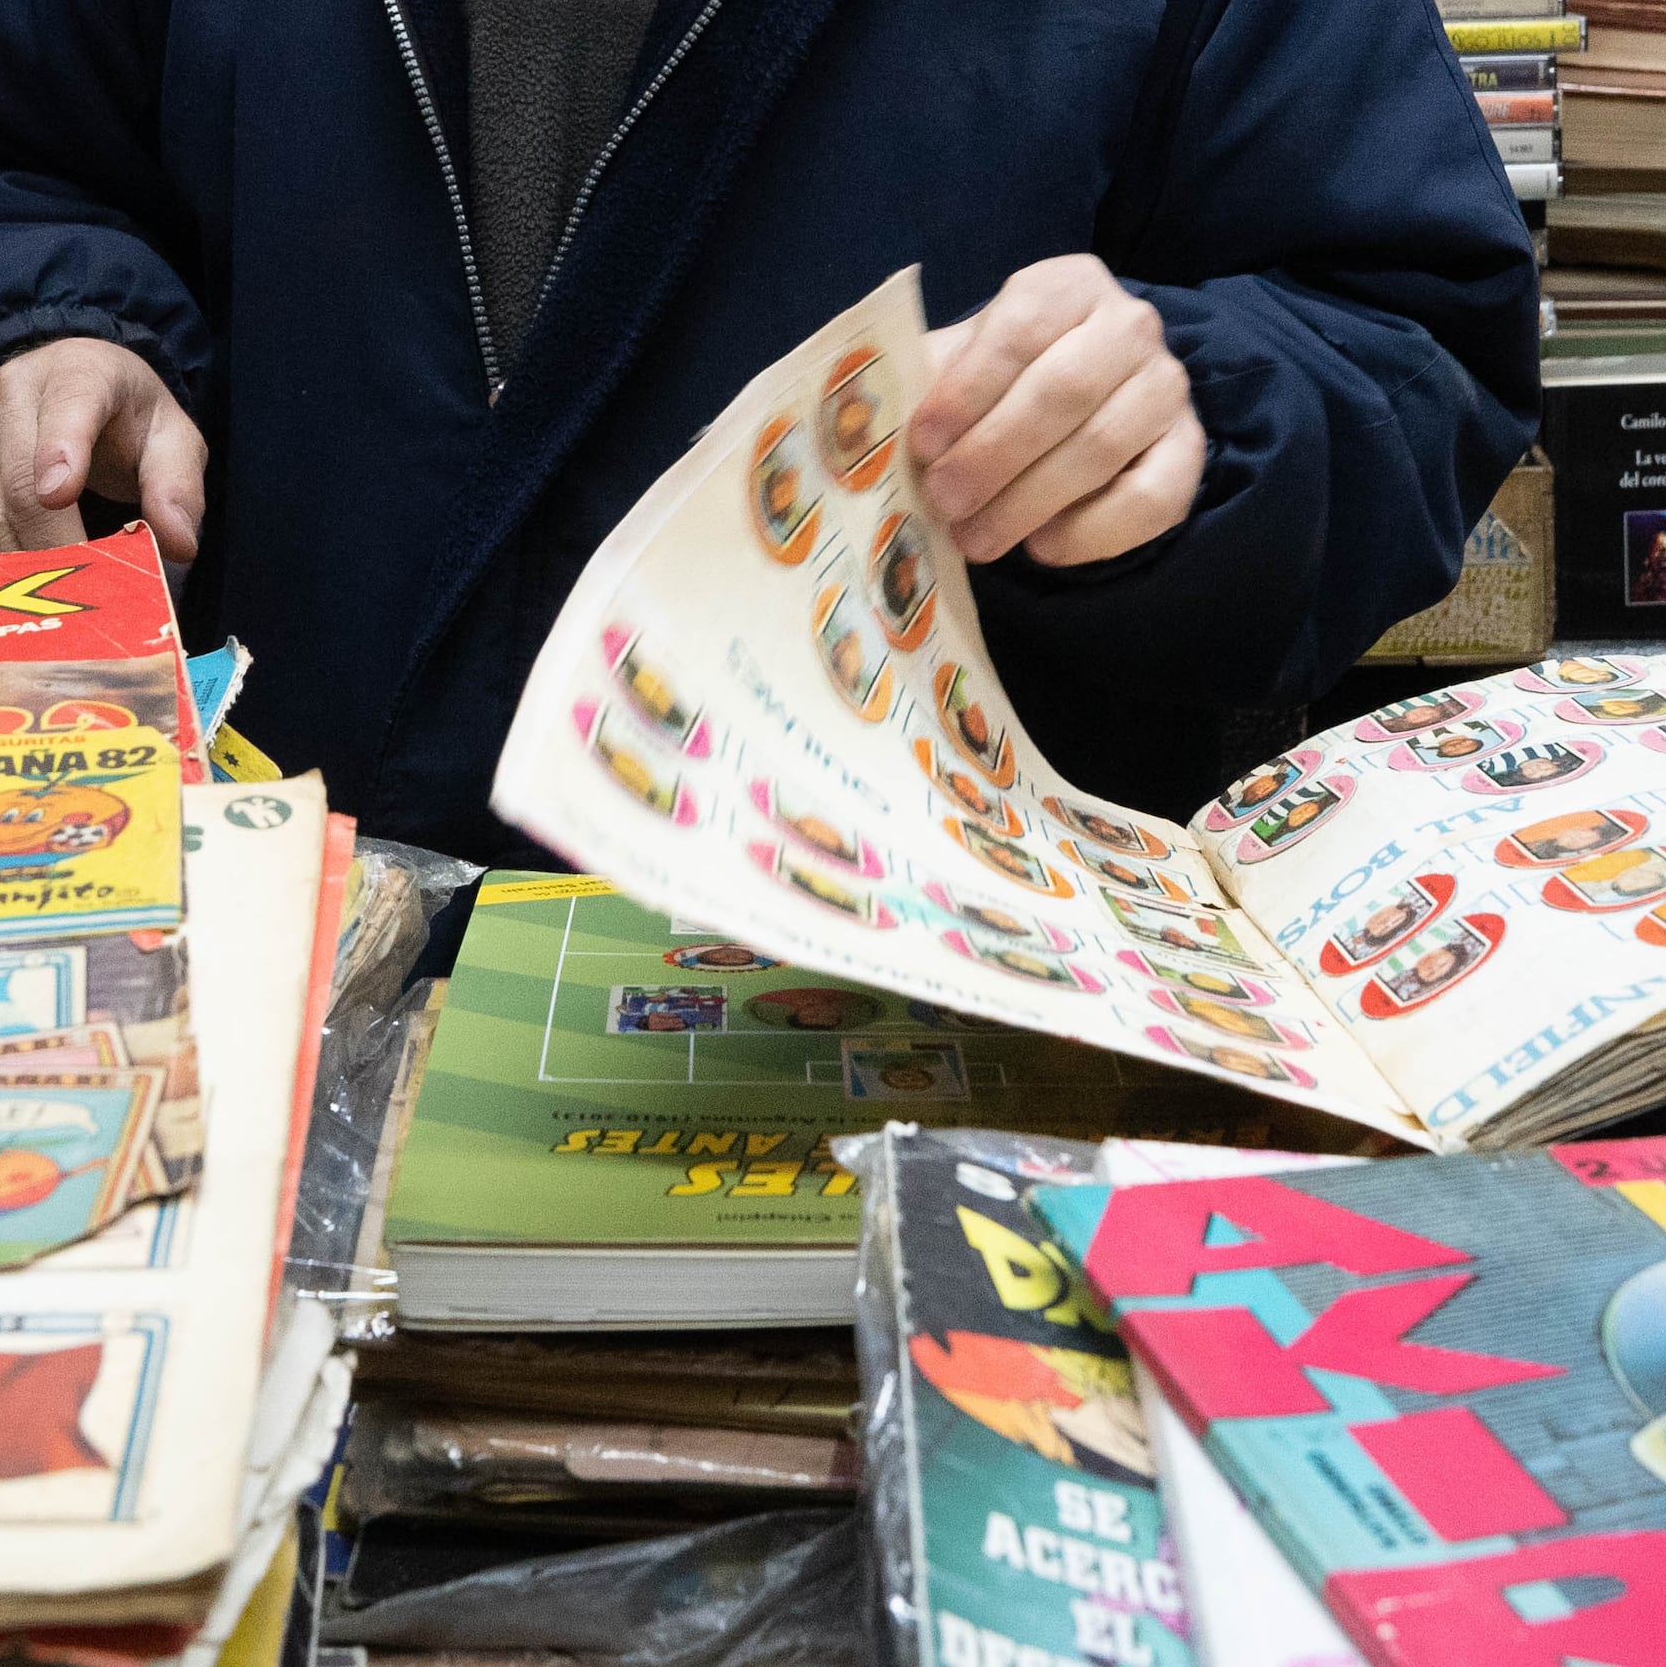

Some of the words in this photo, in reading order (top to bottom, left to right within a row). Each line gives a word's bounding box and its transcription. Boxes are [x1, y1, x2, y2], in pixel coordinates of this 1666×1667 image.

[1620, 412, 1666, 430] Camilo
[1635, 449, 1652, 467] La
[1619, 471, 1640, 489] del
[97, 746, 158, 770] 82
[1413, 793, 1526, 836] ALL
[1276, 840, 1408, 951] BOYS
[551, 1128, 792, 1157] ANTES
[1055, 1480, 1130, 1540] SE
